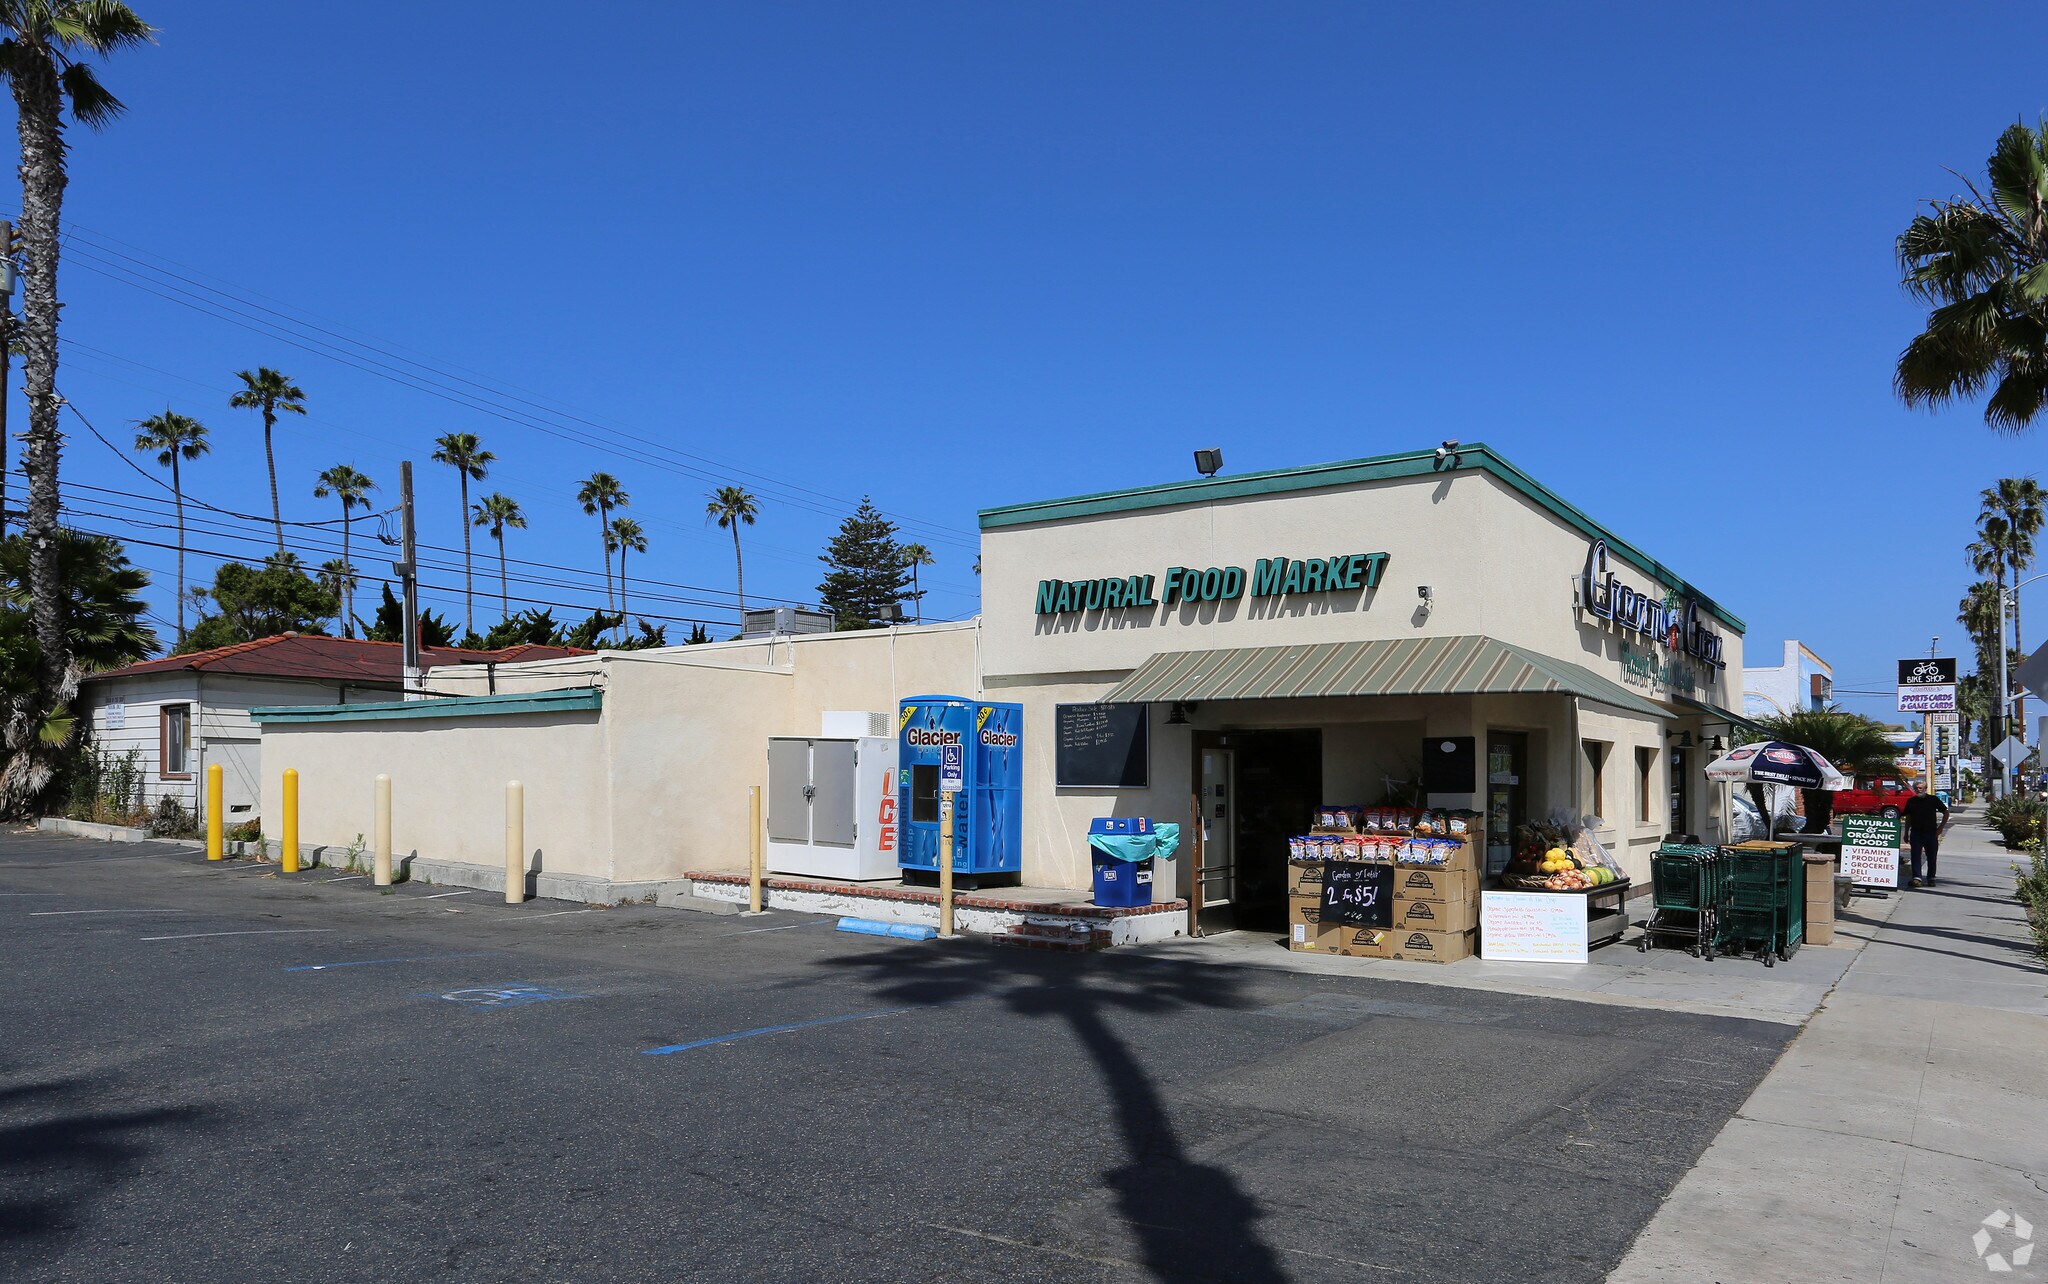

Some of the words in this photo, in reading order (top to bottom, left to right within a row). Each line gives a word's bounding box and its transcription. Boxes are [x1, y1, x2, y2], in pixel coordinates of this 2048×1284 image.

[1035, 574, 1156, 614] NATURAL
[1161, 566, 1245, 604] FOOD
[1250, 552, 1389, 597] MARKET
[1925, 674, 1945, 683] SHOP
[1901, 694, 1928, 702] SPORTS
[1929, 693, 1952, 701] CARDS
[1907, 702, 1928, 710] GAME
[1930, 701, 1953, 709] CARDS
[908, 728, 960, 746] Glacier
[981, 730, 1017, 746] Glacier
[947, 770, 958, 778] Only
[879, 767, 899, 850] ICE
[957, 788, 969, 849] water
[1848, 818, 1896, 828] NATURAL
[1847, 831, 1895, 841] ORGANIC
[1853, 838, 1888, 847] FOODS
[1852, 848, 1891, 856] VITAMINS
[1851, 855, 1888, 863] PRODUCE
[1851, 861, 1895, 870] GROCERIES
[1327, 886, 1338, 905] 2
[1354, 885, 1378, 907] $5!
